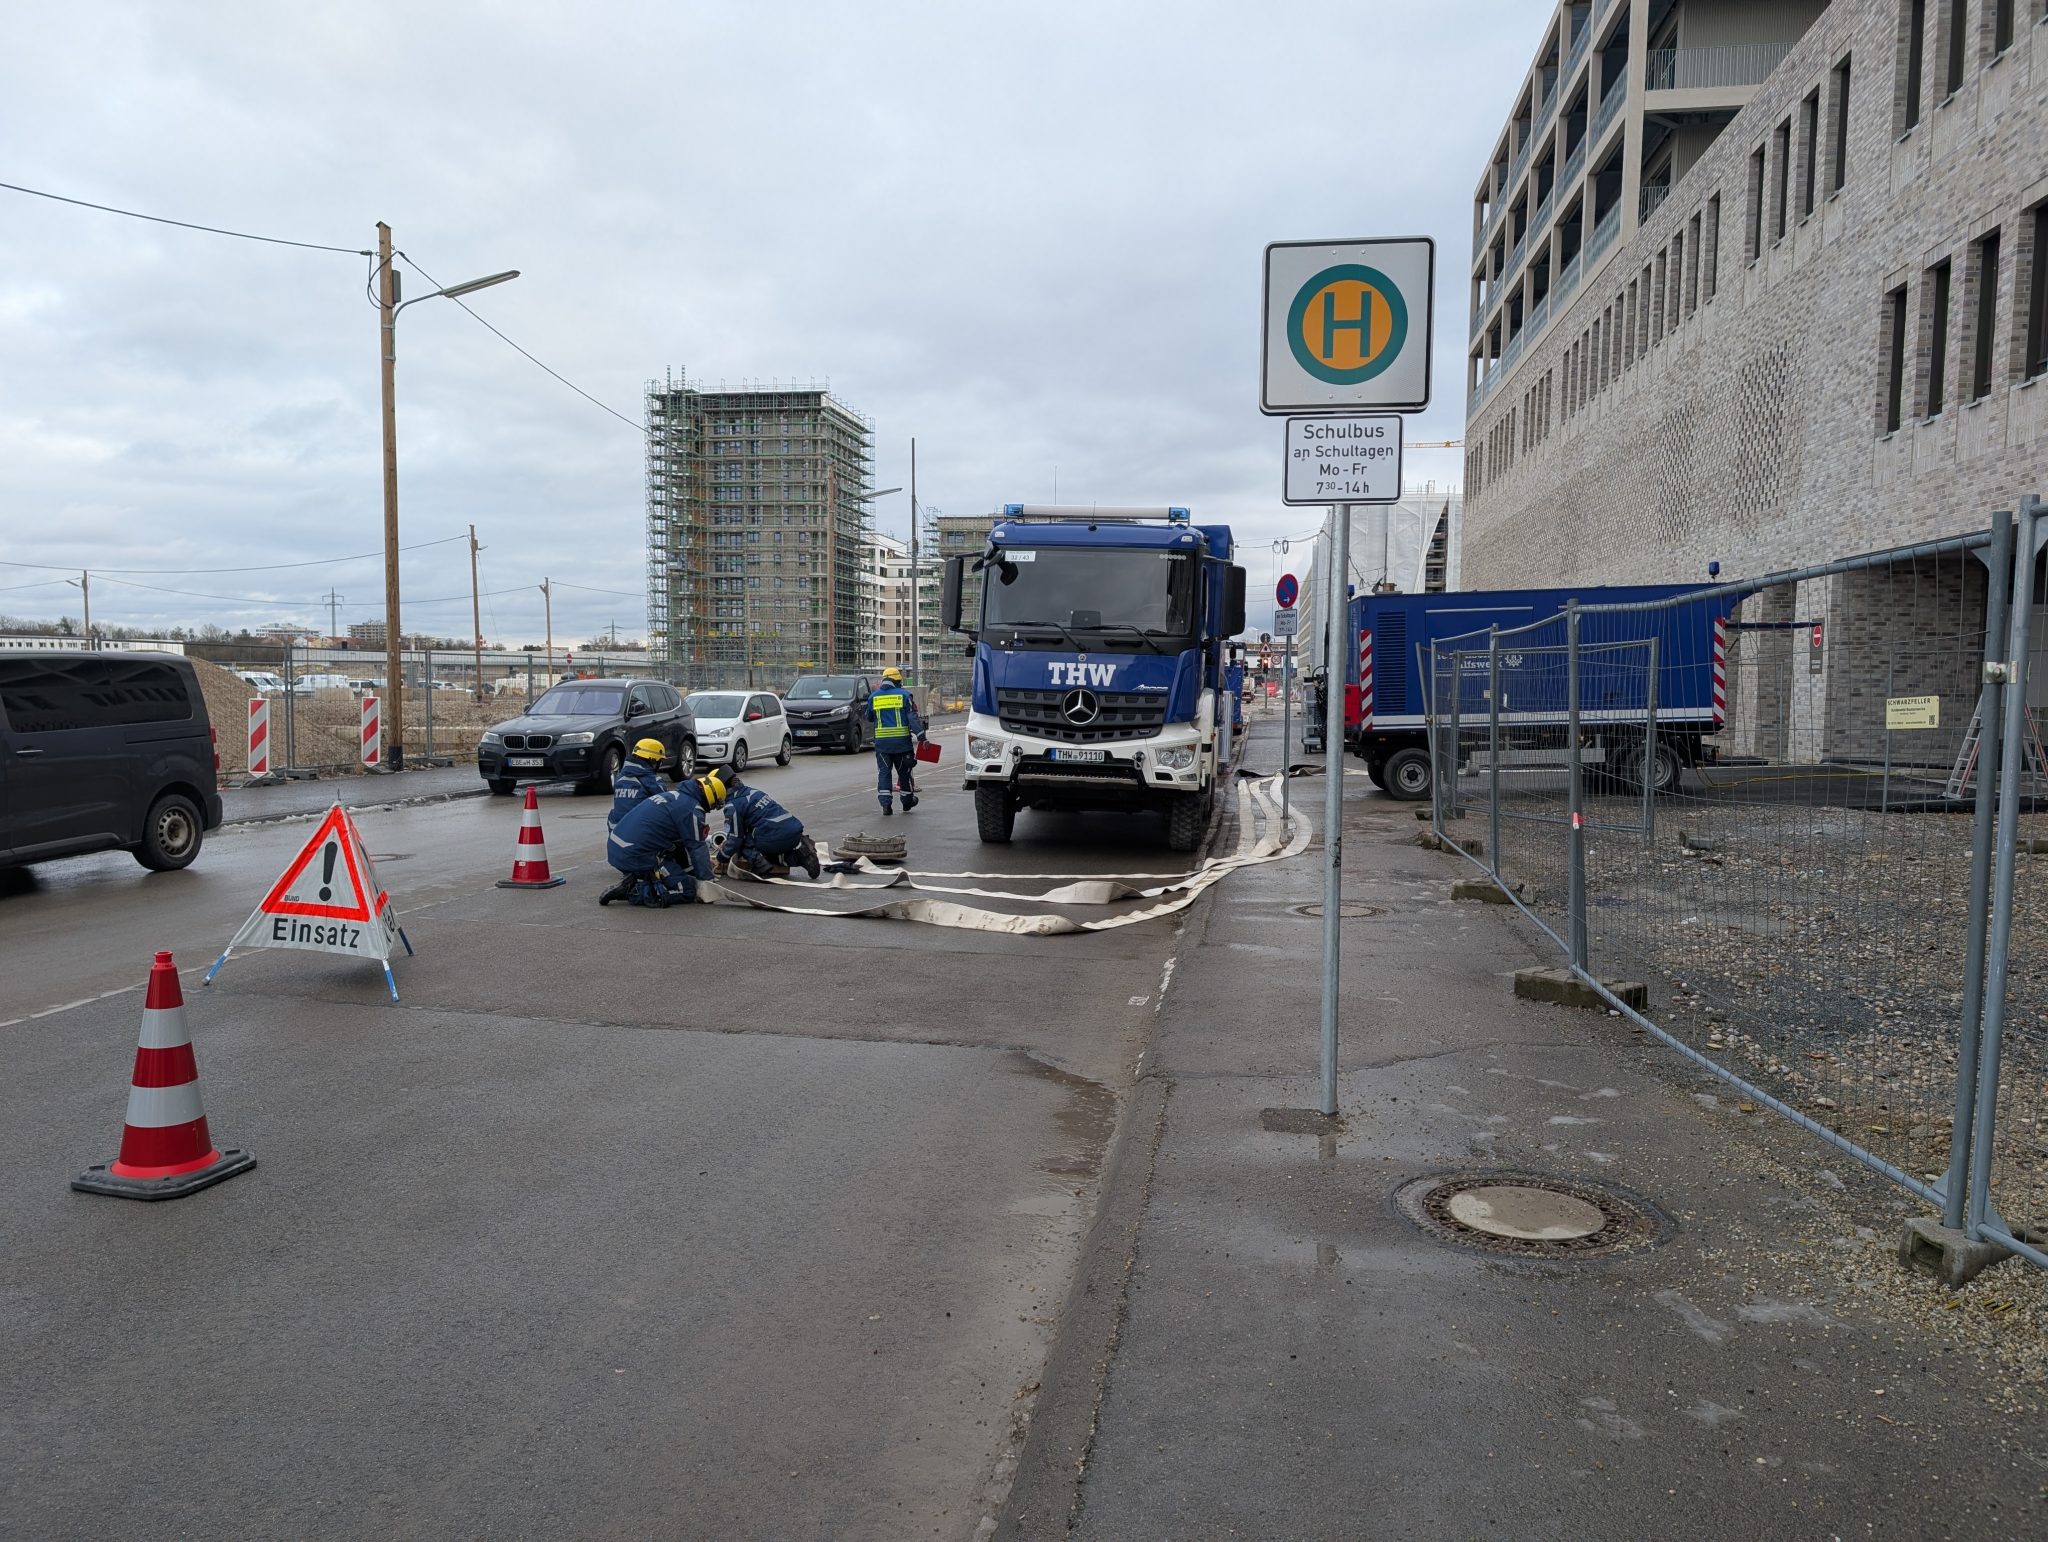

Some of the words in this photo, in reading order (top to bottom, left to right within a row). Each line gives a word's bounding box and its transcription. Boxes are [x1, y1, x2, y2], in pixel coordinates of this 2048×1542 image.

[1323, 291, 1372, 359] H
[1303, 423, 1385, 439] Schulbus
[1293, 447, 1311, 459] an
[1315, 445, 1394, 459] Schultagen
[1048, 662, 1117, 687] THW
[1888, 698, 1931, 706] SCHWARZFELLER
[615, 788, 639, 799] THW
[284, 894, 300, 902] BUND
[272, 917, 361, 949] Einsatz
